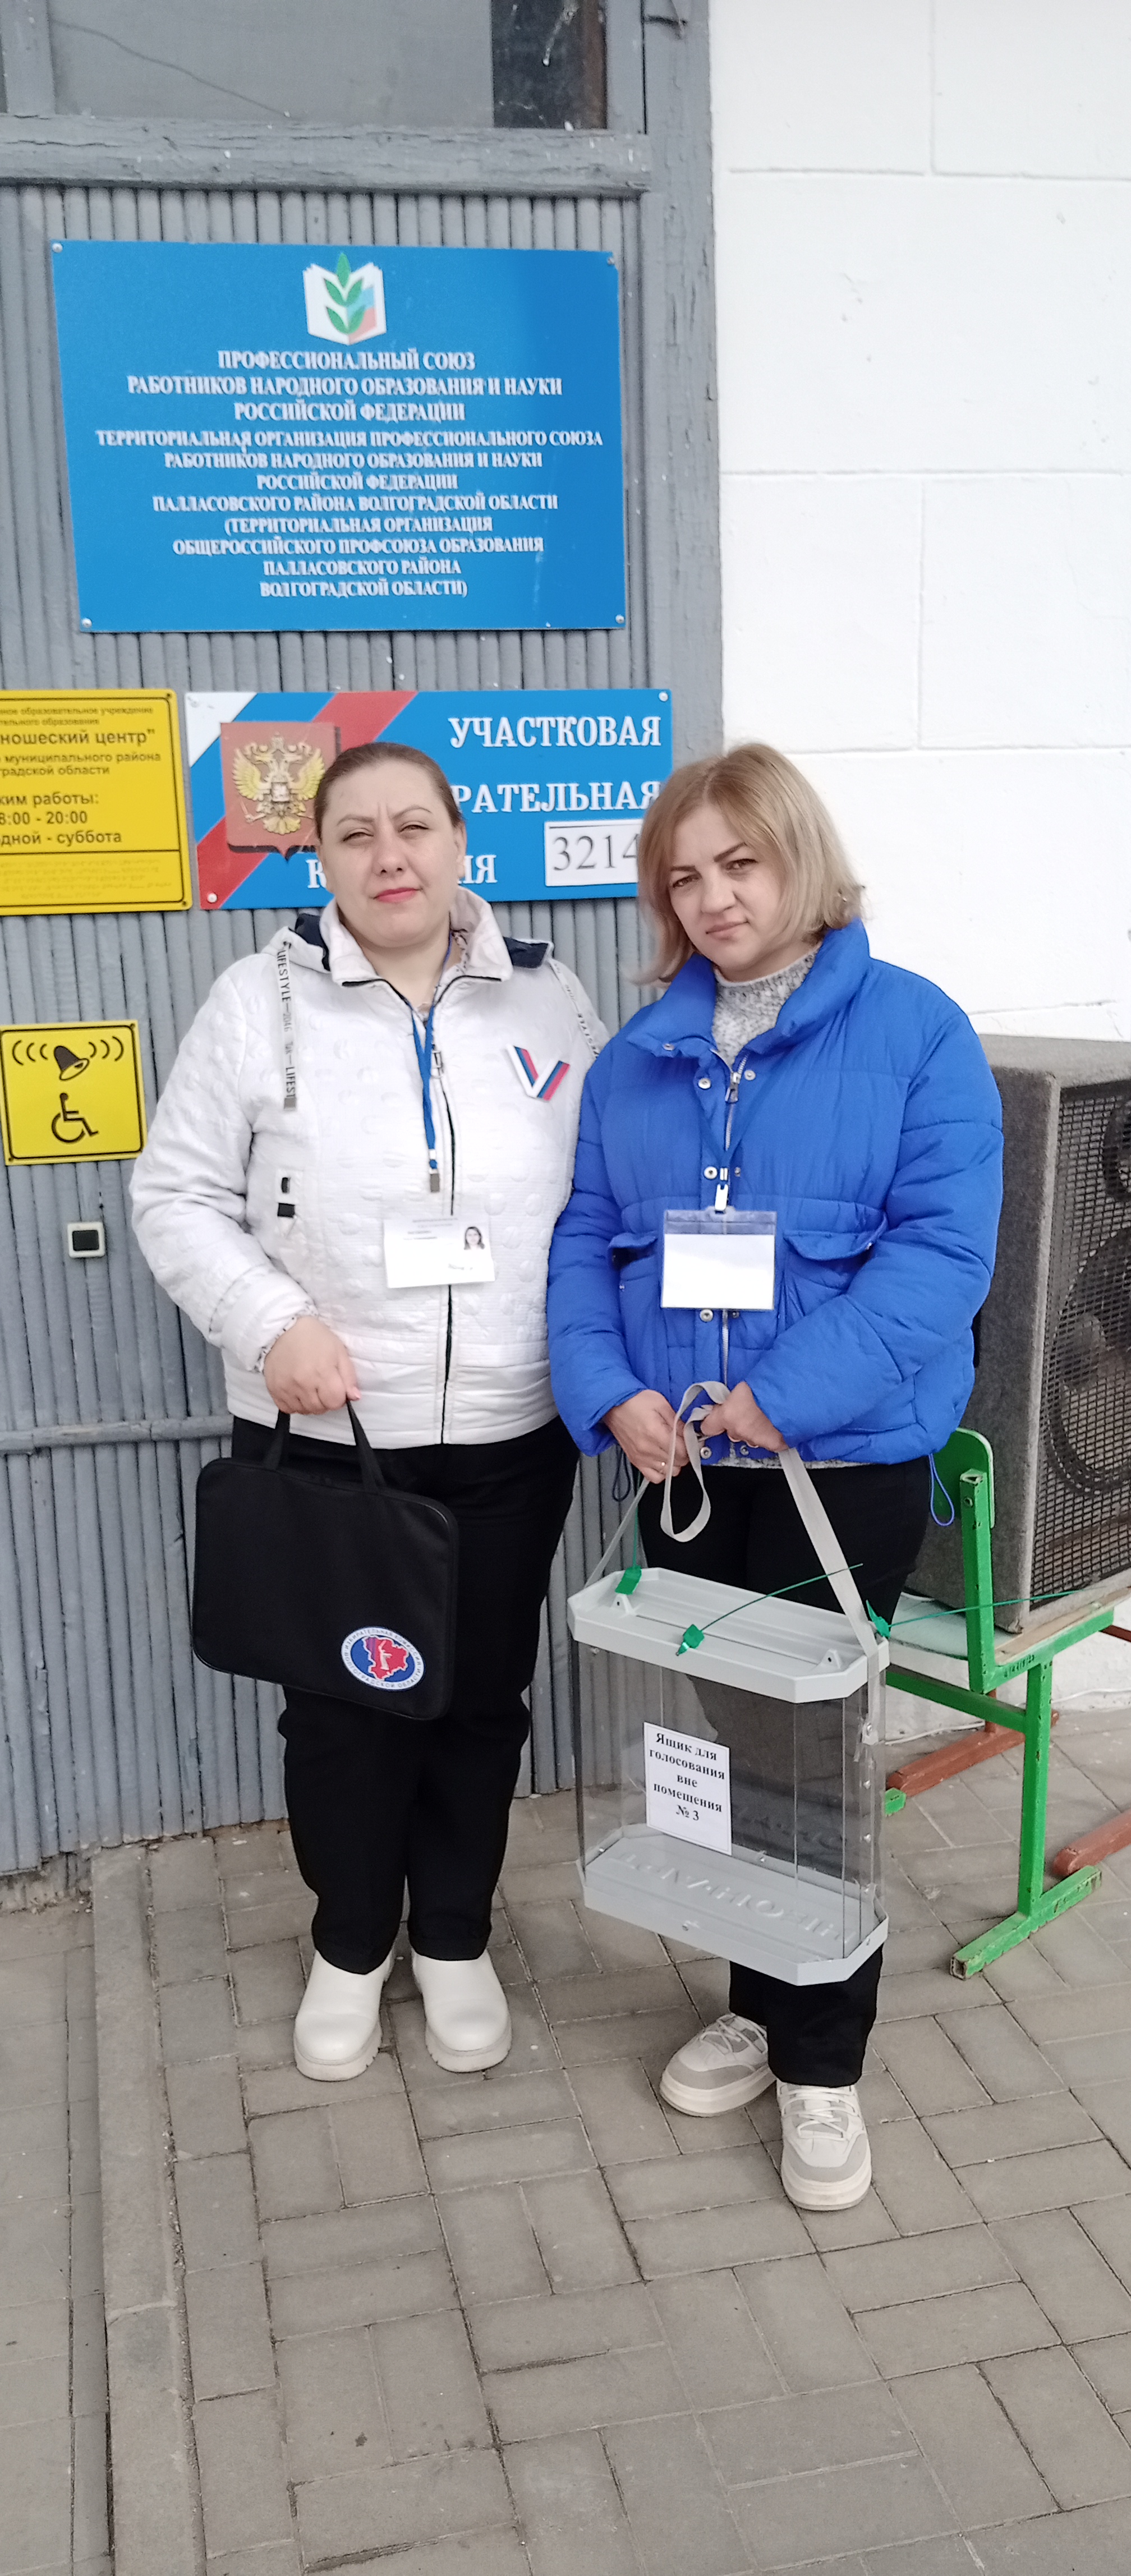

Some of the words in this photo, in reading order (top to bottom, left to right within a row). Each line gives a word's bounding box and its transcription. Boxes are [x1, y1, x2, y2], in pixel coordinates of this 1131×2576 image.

[218, 348, 420, 370] ПРОФЕССИОНАЛЬНЫЙ
[423, 352, 476, 370] СОЮЗ
[127, 376, 247, 394] РАБОТНИКОВ
[250, 376, 358, 397] НАРОДНОГО
[361, 378, 484, 395] ОБРАЗОВАНИЯ
[488, 378, 500, 395] И
[504, 378, 562, 395] НАУКИ
[234, 399, 357, 421] РОССИЙСКОЙ
[360, 403, 465, 422] ФЕДЕРАЦИИ
[95, 430, 252, 447] ТЕРРИТОРИАЛЬНАЯ
[255, 431, 367, 449] ОРГАНИЗАЦИЯ
[370, 431, 547, 447] ПРОФЕССИОНАЛЬНОГО
[549, 431, 603, 446] СОЮЗА
[164, 452, 268, 468] РАБОТНИКОВ
[271, 453, 365, 471] НАРОДНОГО
[367, 453, 474, 468] ОБРАЗОВАНИЯ
[477, 452, 489, 467] И
[491, 453, 542, 467] НАУКИ
[256, 471, 364, 490] РОССИЙСКОЙ
[366, 474, 458, 491] ФЕДЕРАЦИИ
[152, 496, 291, 512] ПАЛЛАСОВСКОГО
[294, 493, 356, 512] РАЙОНА
[358, 493, 486, 513] ВОЛГОГРАДСКОЙ
[489, 494, 558, 510] ОБЛАСТИ
[224, 518, 381, 536] (ТЕРРИТОРИАЛЬНАЯ
[384, 517, 493, 534] ОРГАНИЗАЦИЯ
[173, 536, 337, 556] ОБЩЕРОССИЙСКОГО
[339, 539, 436, 554] ПРОФСОЮЗА
[439, 537, 544, 553] ОБРАЗОВАНИЯ
[263, 560, 399, 576] ПАЛЛАСОВСКОГО
[401, 557, 461, 574] РАЙОНА
[260, 578, 389, 598] ВОЛГОГРАДСКОЙ
[392, 580, 468, 597] ОБЛАСТИ)
[95, 728, 155, 747] центр"
[449, 716, 661, 748] УЧАСТКОВАЯ
[4, 753, 113, 765] муниципального
[116, 752, 161, 765] района
[0, 765, 54, 778] радской
[58, 765, 110, 775] области
[33, 791, 99, 808] работы:
[449, 780, 661, 813] РАТЕЛЬНАЯ
[46, 811, 88, 825] 20:00
[57, 830, 122, 847] суббота
[656, 1732, 692, 1754] Ящик
[695, 1747, 717, 1761] для
[649, 1749, 725, 1780] голосования
[677, 1774, 698, 1788] вне
[654, 1783, 723, 1813] помещения
[676, 1804, 690, 1819] №
[692, 1810, 700, 1821] 3
